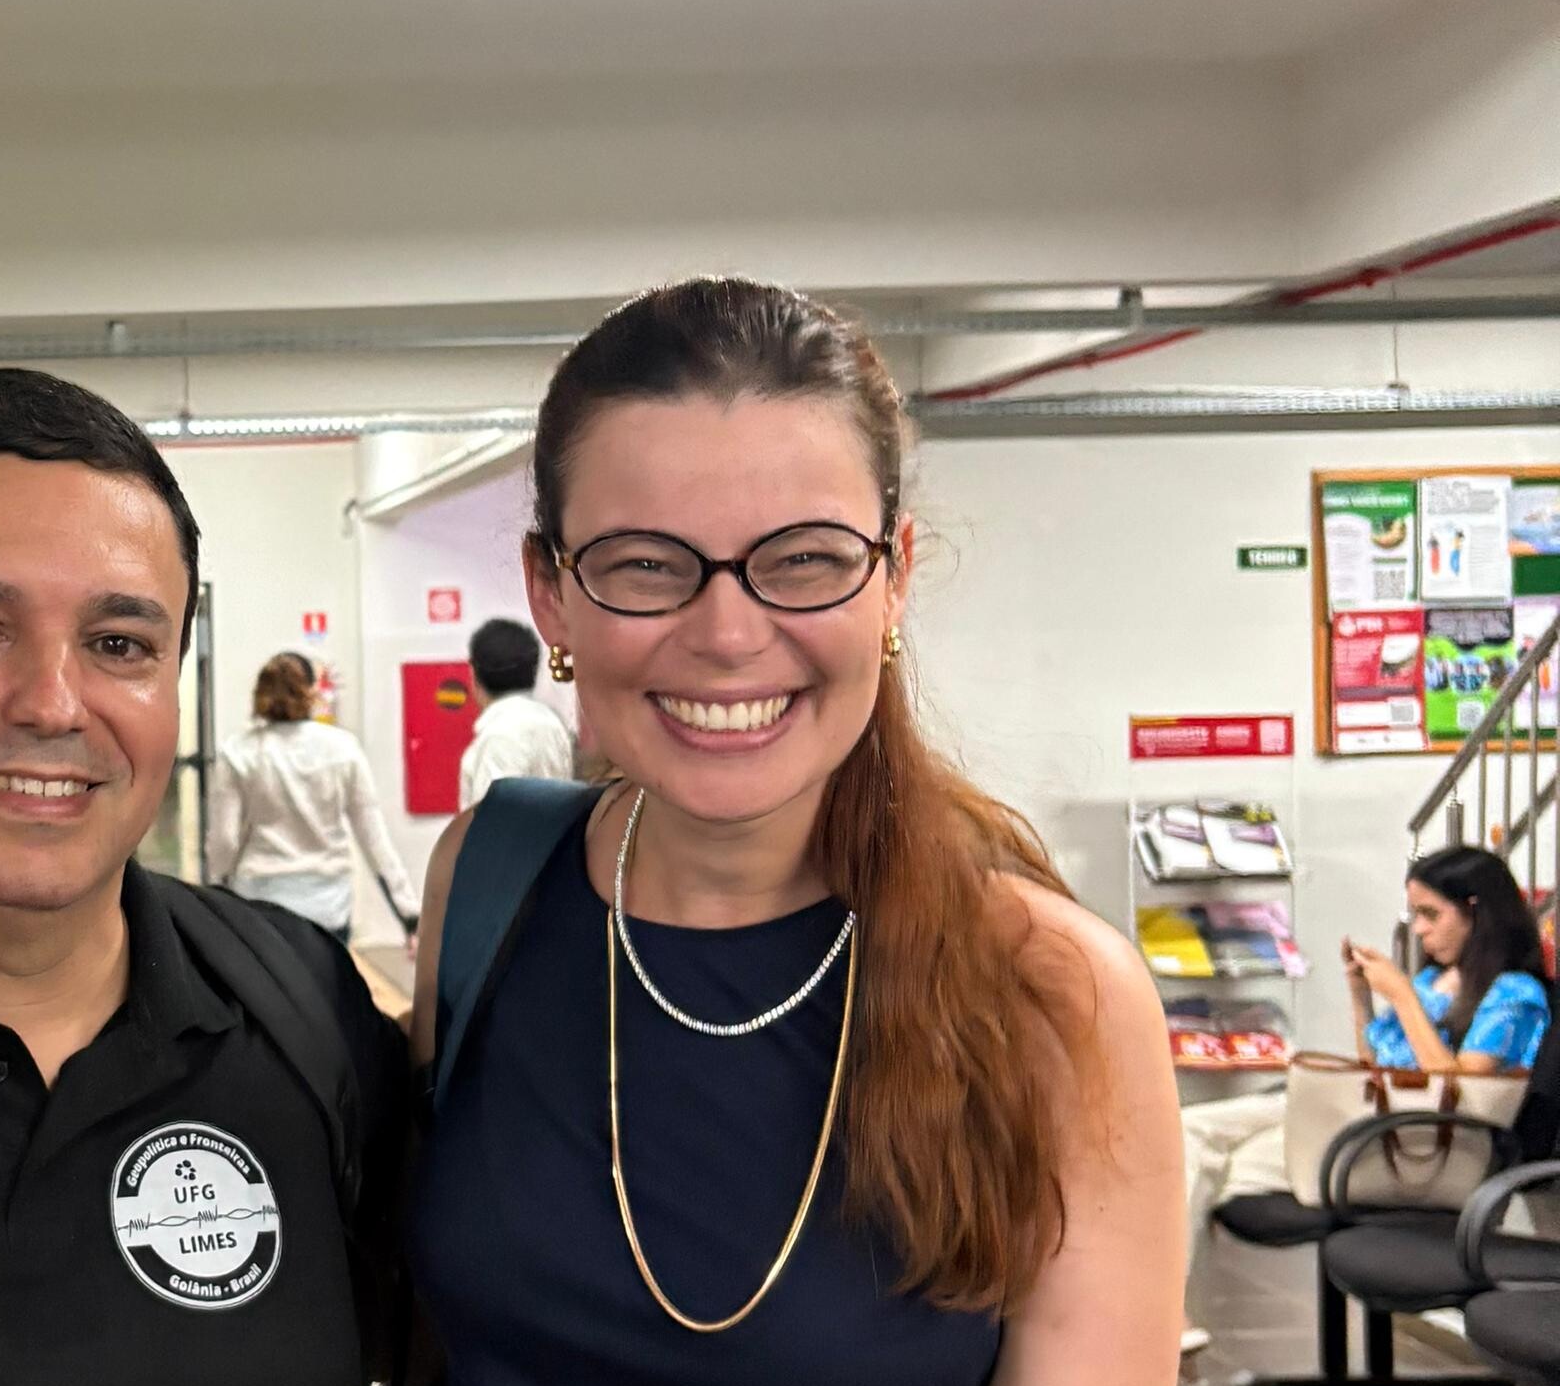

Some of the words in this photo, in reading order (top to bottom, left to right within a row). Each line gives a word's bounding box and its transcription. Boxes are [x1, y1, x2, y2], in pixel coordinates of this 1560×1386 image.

[179, 1135, 188, 1145] e
[190, 1133, 250, 1174] Fronteiras
[174, 1184, 215, 1204] UFG
[179, 1231, 237, 1254] LIMES
[169, 1274, 222, 1297] Goiânia
[229, 1262, 262, 1292] Brasil
